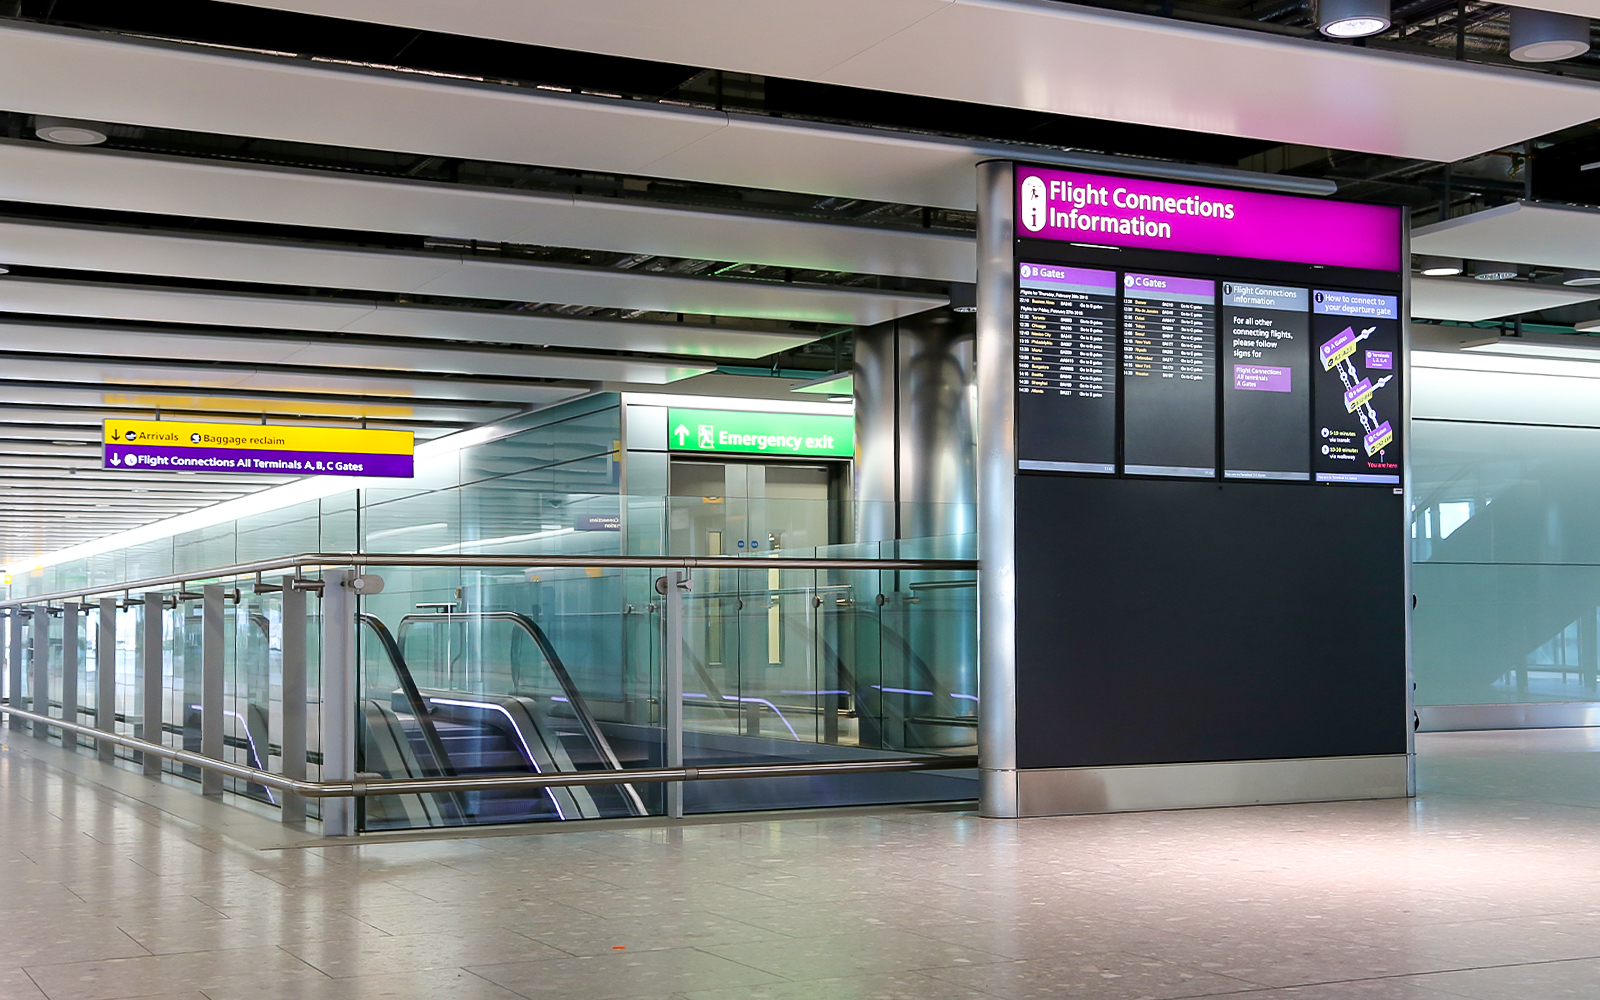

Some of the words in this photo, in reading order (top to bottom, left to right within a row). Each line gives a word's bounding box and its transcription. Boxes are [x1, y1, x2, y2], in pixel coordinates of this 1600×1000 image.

[1050, 180, 1108, 208] Flight
[1112, 187, 1235, 220] Connections
[1050, 207, 1171, 238] Information
[1032, 267, 1038, 276] B
[1040, 268, 1065, 279] Gates
[1135, 277, 1141, 286] C
[1143, 278, 1166, 288] Gates
[1234, 286, 1253, 295] Flight
[1255, 287, 1297, 298] Connections
[1234, 295, 1275, 305] information
[1342, 305, 1375, 314] departure
[1234, 316, 1244, 324] For
[1233, 328, 1269, 338] connecting
[1271, 330, 1293, 339] flights,
[1233, 338, 1255, 347] please
[1256, 339, 1277, 348] follow
[1234, 349, 1251, 358] signs
[1252, 350, 1262, 358] for
[138, 430, 179, 442] Arrivals
[203, 433, 247, 446] Baggage
[249, 434, 285, 446] reclaim
[719, 430, 802, 451] Emergency
[805, 435, 834, 449] exit
[137, 454, 168, 469] Flight
[170, 455, 235, 469] Connections
[237, 458, 251, 468] All
[253, 458, 302, 470] Terminals
[304, 460, 315, 471] A,
[316, 462, 325, 472] B,
[326, 462, 333, 471] C
[335, 462, 364, 472] Gates
